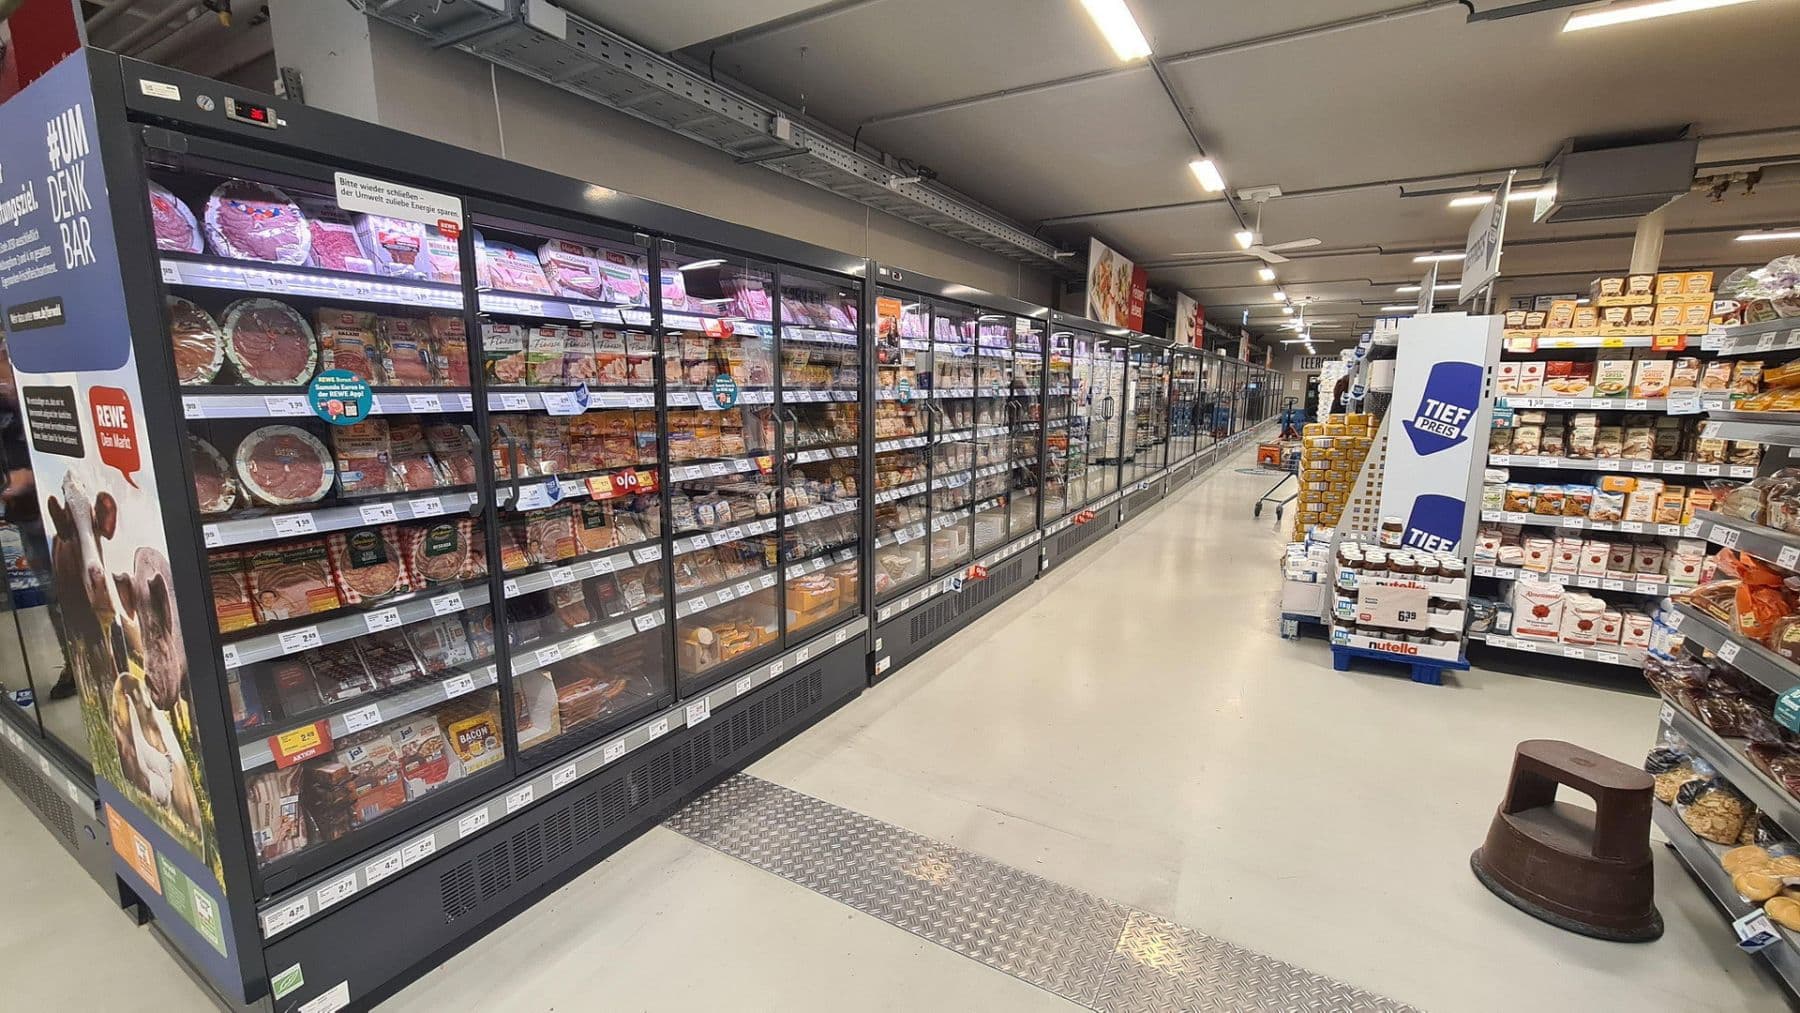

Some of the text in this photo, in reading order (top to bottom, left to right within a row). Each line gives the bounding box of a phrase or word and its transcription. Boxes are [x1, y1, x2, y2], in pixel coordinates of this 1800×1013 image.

[47, 104, 89, 171] #UM
[47, 160, 92, 223] DENK
[339, 177, 358, 189] Bitte
[359, 183, 385, 195] wieder
[386, 187, 419, 201] schließen
[340, 187, 460, 219] der Umwelt zuliebe Energie sparen.
[60, 216, 96, 270] BAR
[96, 405, 128, 429] REWE
[1425, 399, 1471, 427] TIEF
[1420, 418, 1456, 438] PREIS
[100, 432, 132, 450] Dein Markt
[1398, 610, 1416, 623] 6.39
[1368, 641, 1418, 659] nutella
[400, 726, 414, 740] ja!
[459, 726, 490, 746] BACON
[292, 748, 317, 763] AKTION
[349, 746, 364, 761] ja!
